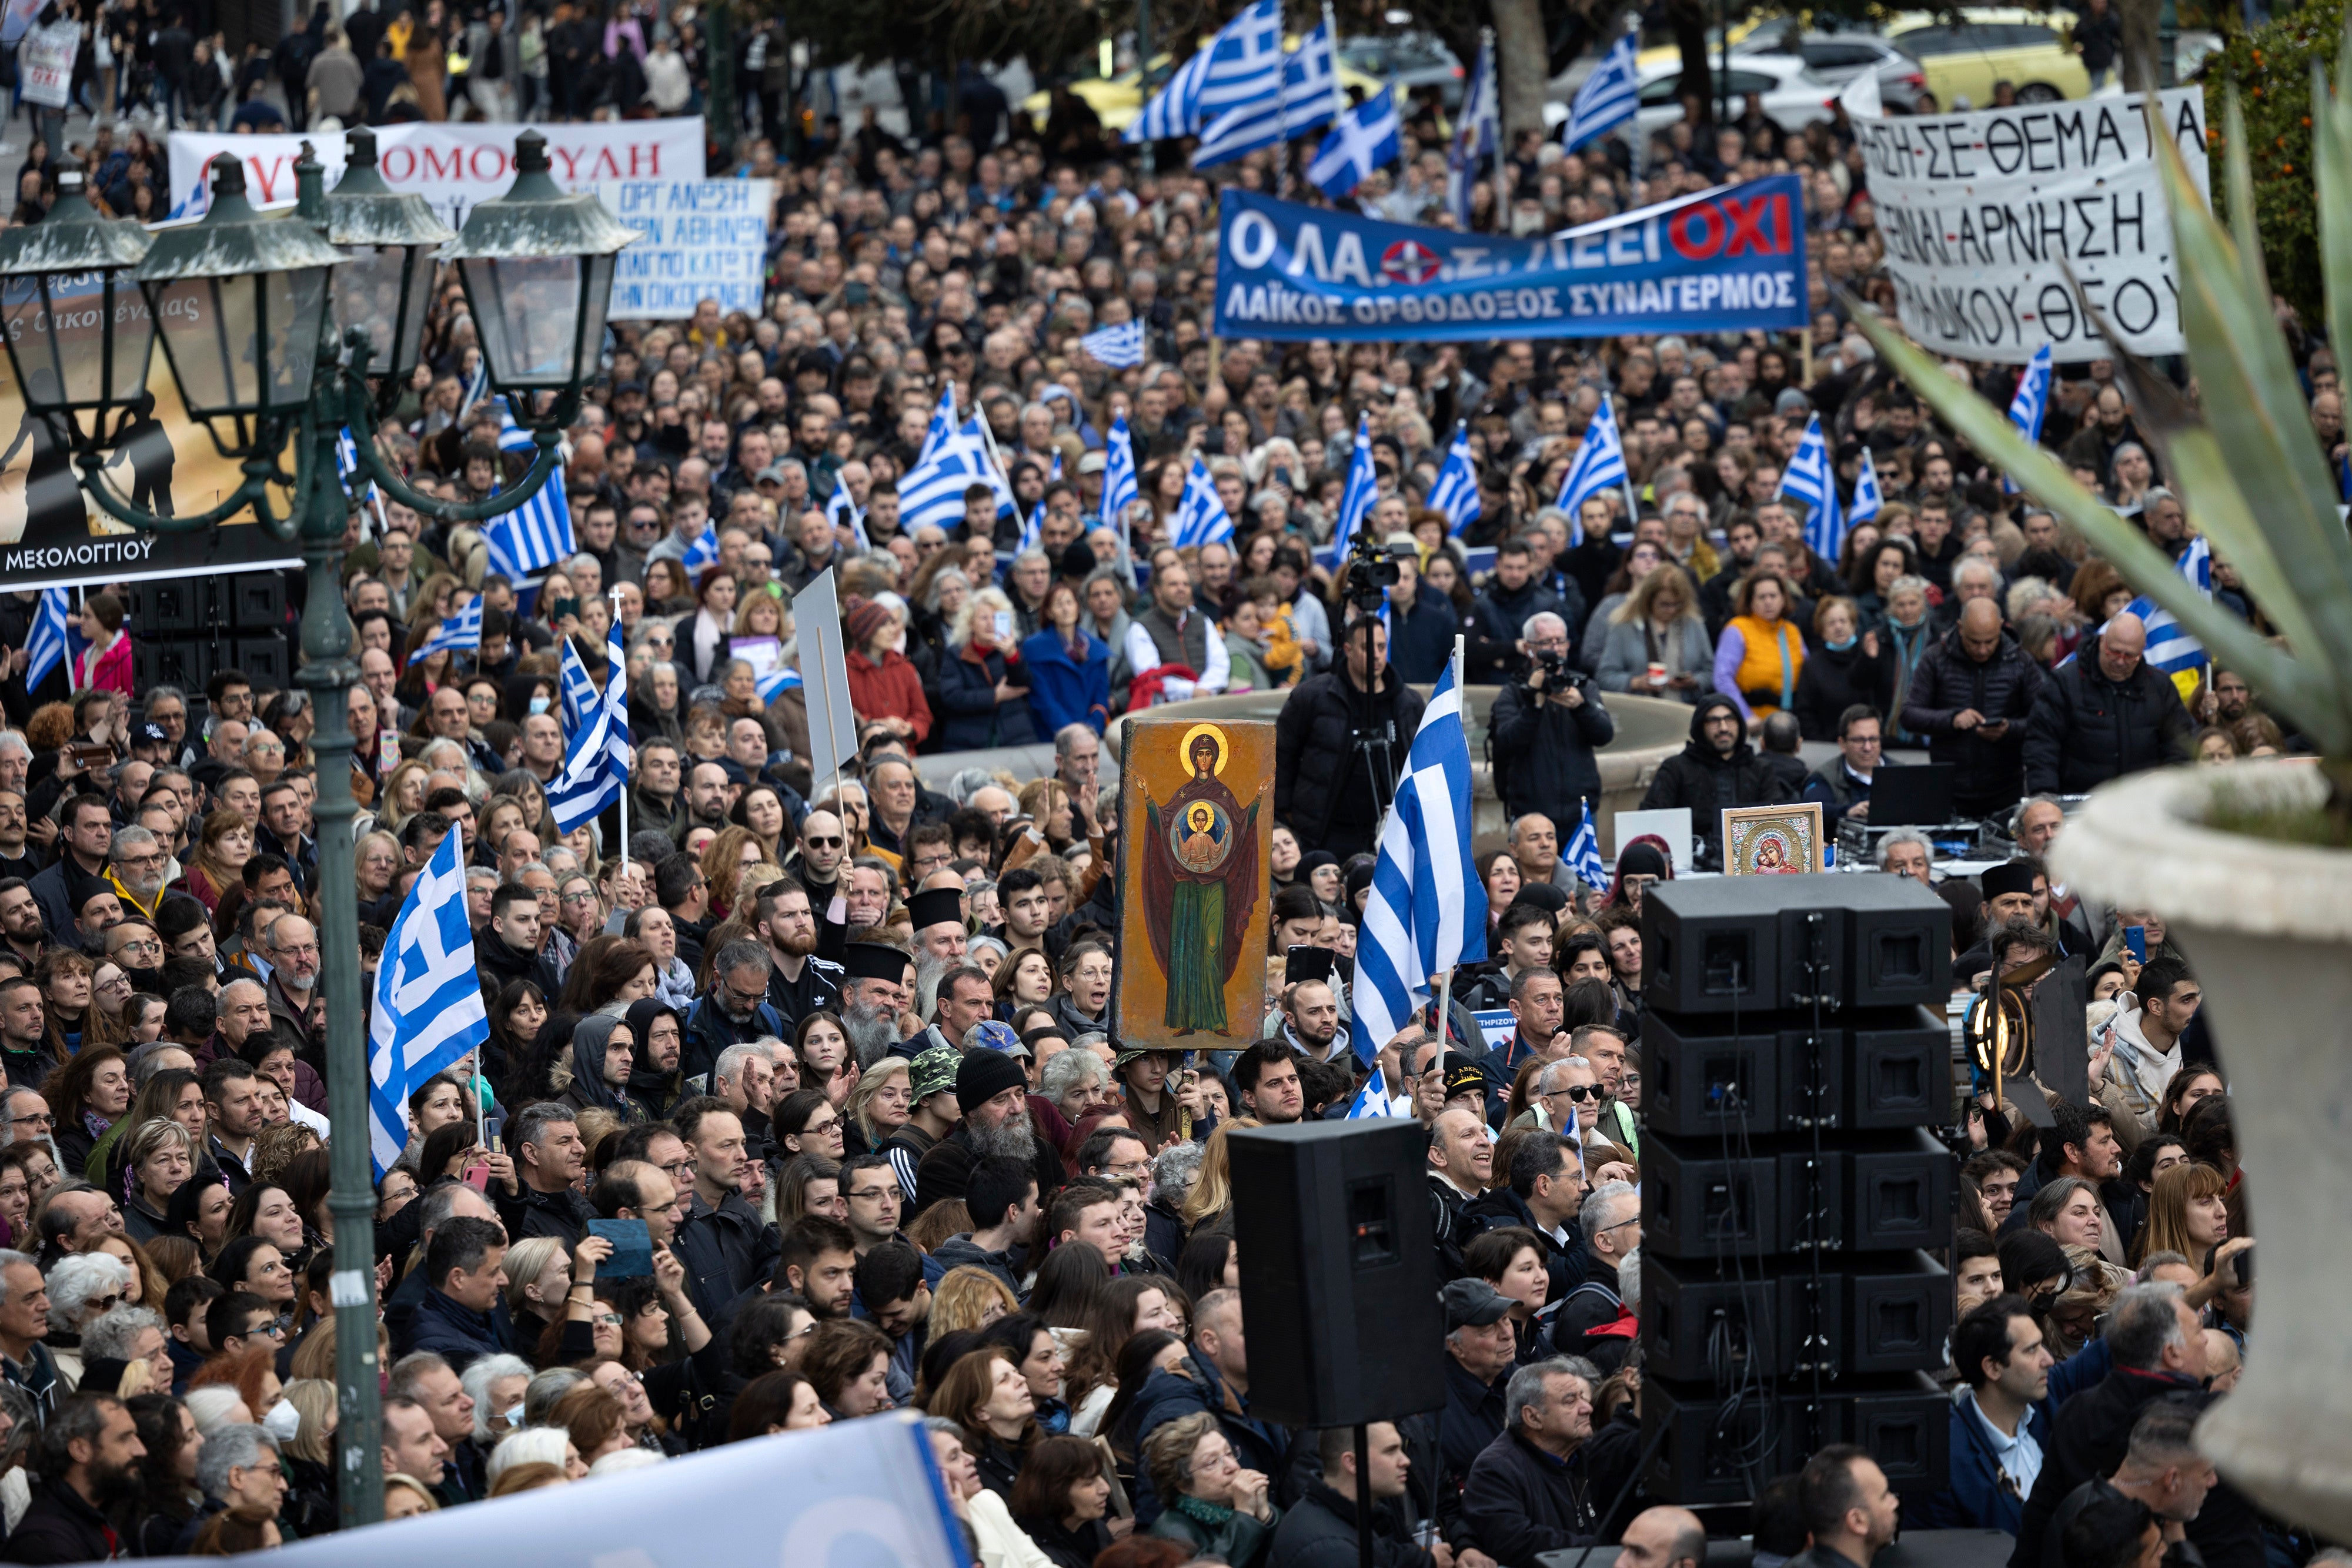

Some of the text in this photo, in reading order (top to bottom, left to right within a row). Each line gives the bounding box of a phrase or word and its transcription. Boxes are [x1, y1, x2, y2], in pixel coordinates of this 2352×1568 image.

[381, 143, 661, 183] ΟΜΟΥΛΗ
[1229, 209, 1278, 270] Ο
[1668, 193, 1793, 260] ΟΧΙ
[1354, 287, 1563, 325] ΟΡΘΟΔΟΞΟΣ
[1569, 271, 1796, 316] ΣΥΝΑΓΕΡΜΟΣ
[6, 539, 153, 571] ΜΕΣΟΛΟΓΓΙΟΥ
